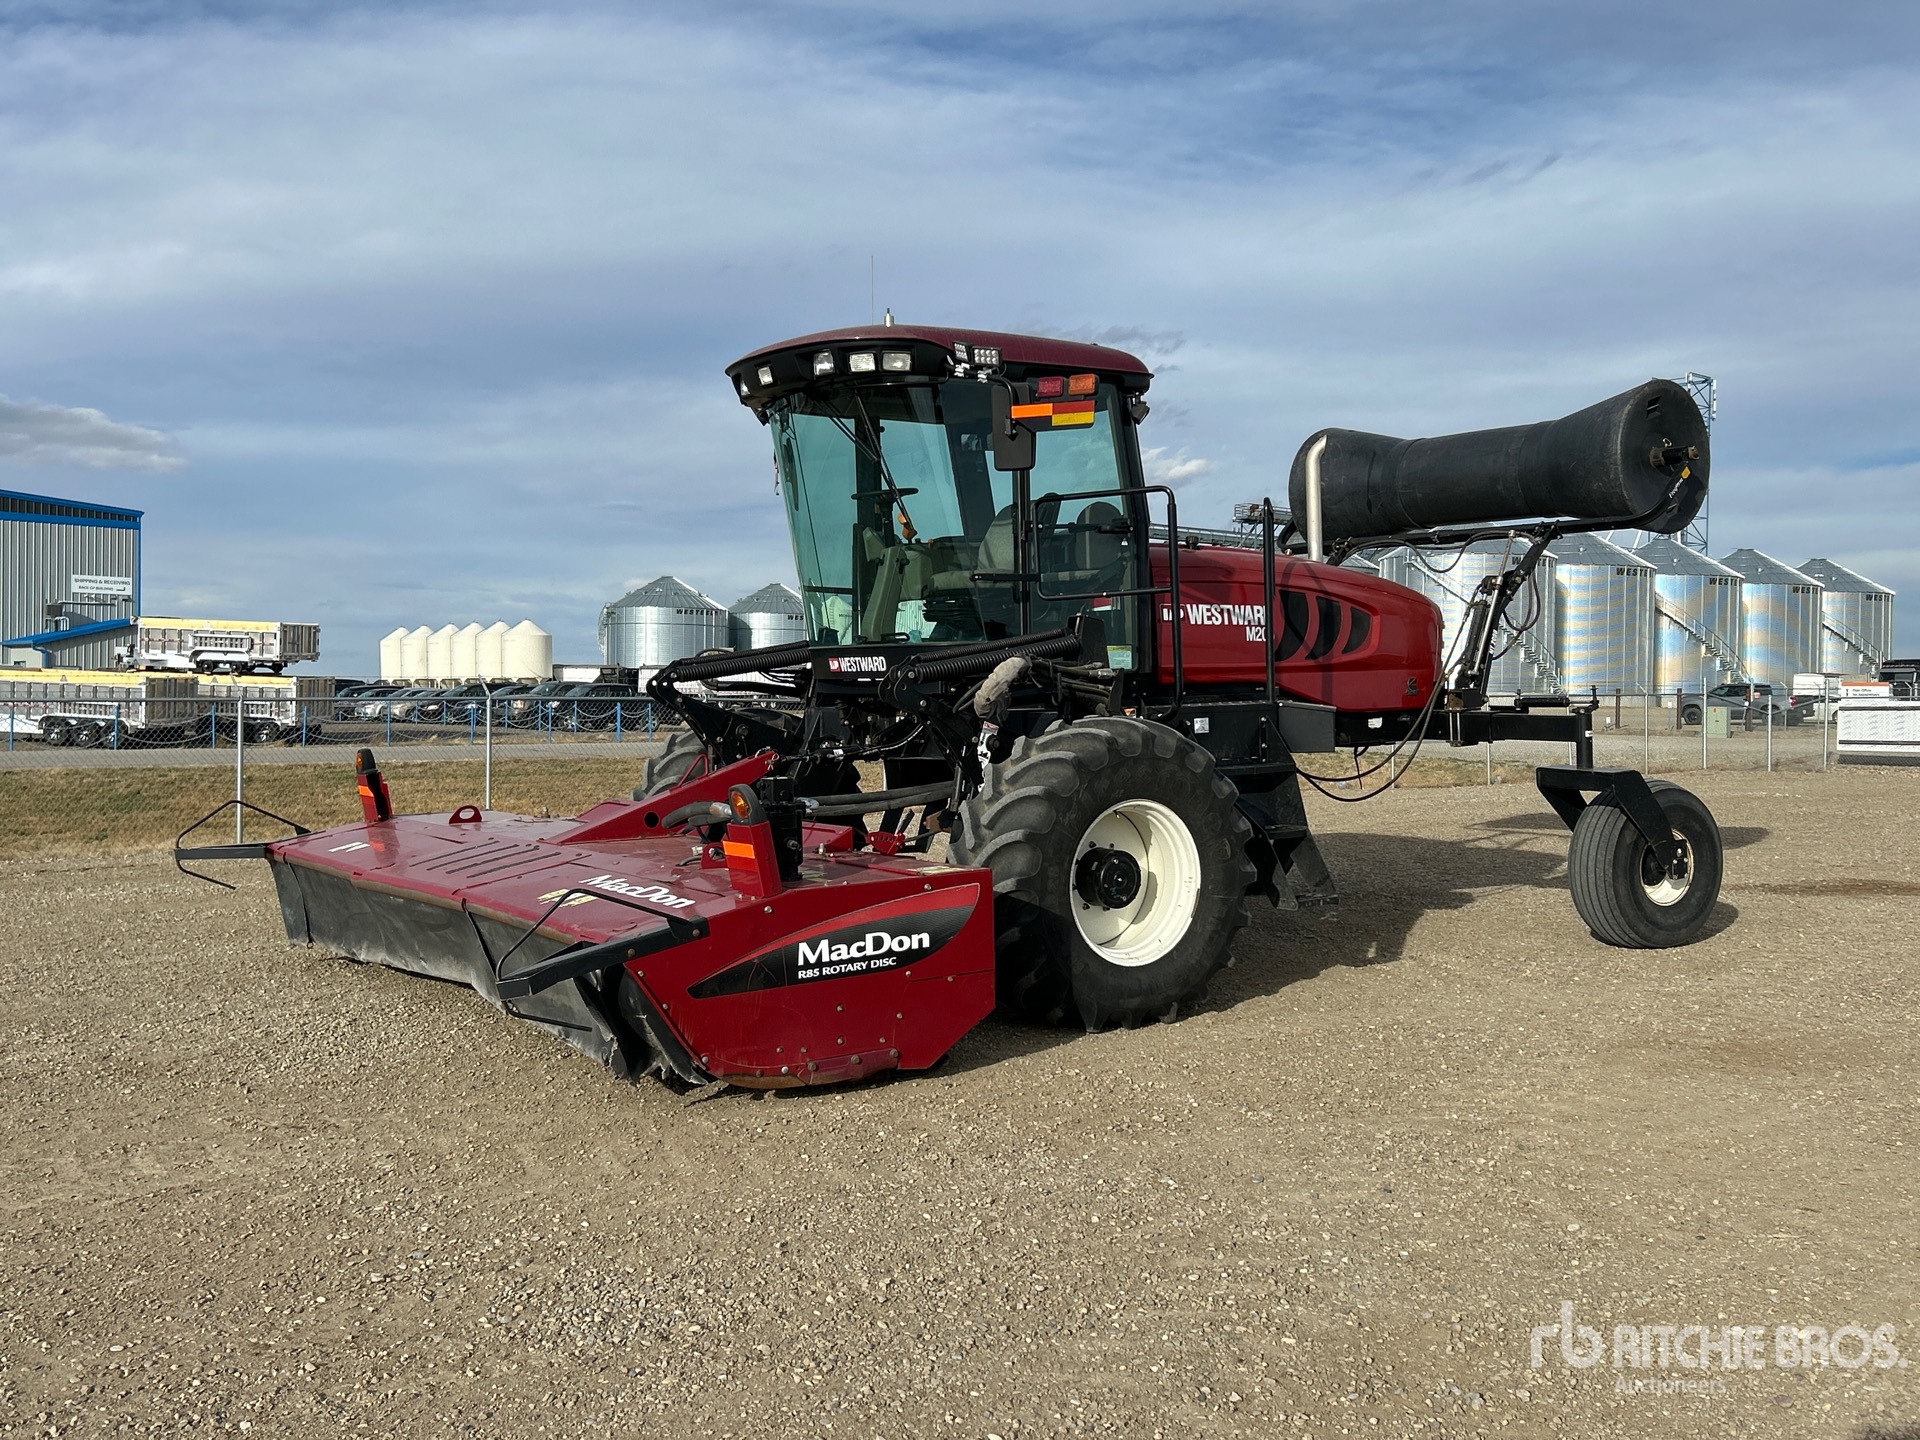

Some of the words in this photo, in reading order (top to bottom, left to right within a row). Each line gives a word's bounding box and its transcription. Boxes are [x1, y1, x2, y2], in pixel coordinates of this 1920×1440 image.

[1186, 604, 1266, 625] WESTWAR
[839, 656, 887, 672] WESTWARD
[578, 874, 696, 909] MacDon
[797, 931, 930, 966] MacDon
[798, 967, 820, 979] R85
[822, 960, 869, 976] ROTARY
[870, 956, 897, 969] DISC
